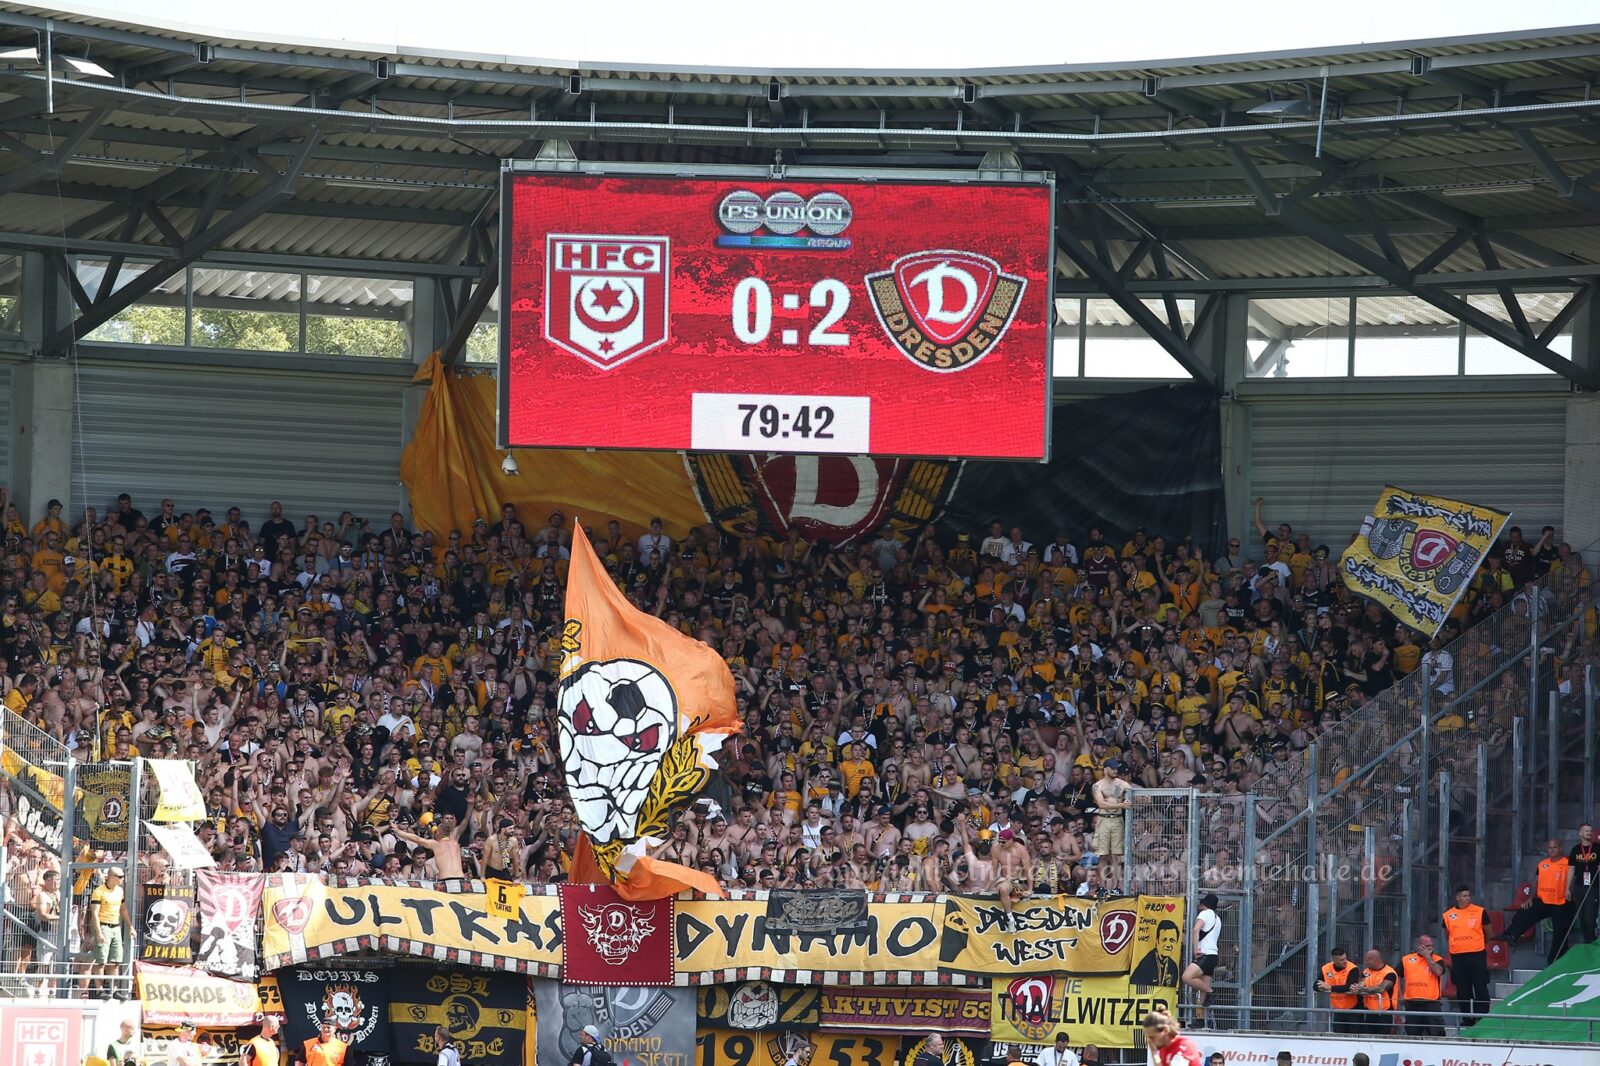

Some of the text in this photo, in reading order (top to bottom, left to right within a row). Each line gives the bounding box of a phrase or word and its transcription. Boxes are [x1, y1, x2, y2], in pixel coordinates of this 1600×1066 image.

[728, 205, 842, 220] PS UNION
[561, 244, 654, 270] HFC
[909, 260, 978, 324] D
[732, 276, 851, 346] 0:2
[886, 312, 1003, 368] DRESDEN
[738, 403, 834, 439] 79:42
[498, 886, 507, 904] 6
[608, 910, 625, 928] D
[974, 906, 1093, 934] DRESDEN
[1103, 914, 1129, 945] D
[992, 938, 1078, 967] WEST
[296, 969, 379, 983] DEVILS
[145, 983, 226, 1005] BRIGADE
[820, 995, 960, 1020] AKTIVIST
[962, 1001, 991, 1021] 53
[22, 1025, 60, 1040] HFC
[354, 1005, 379, 1044] Dresden
[414, 1033, 504, 1060] BNDE
[603, 1036, 662, 1053] DYNAMO
[1220, 1050, 1348, 1066] Wohn-entrum
